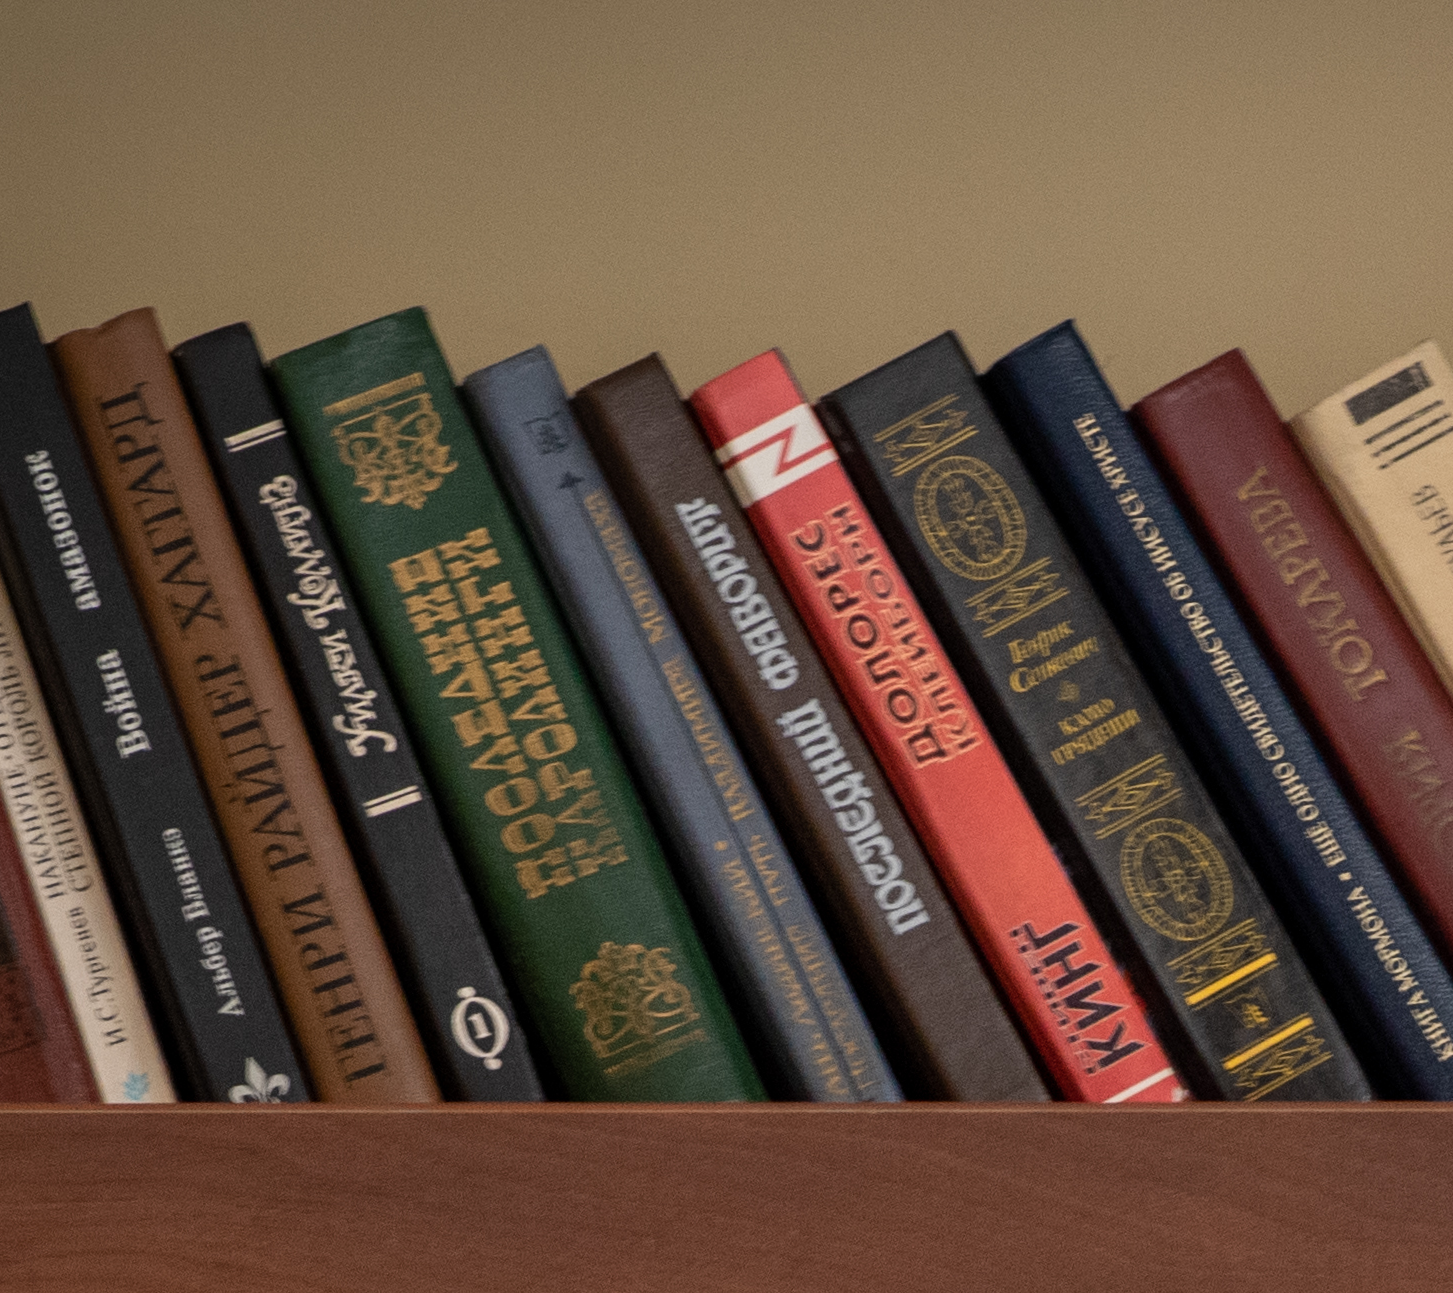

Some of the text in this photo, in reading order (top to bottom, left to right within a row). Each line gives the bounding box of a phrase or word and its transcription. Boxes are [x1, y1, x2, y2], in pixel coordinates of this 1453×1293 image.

[21, 447, 154, 760] Война амазонок
[248, 469, 399, 765] Уилки Коллинз
[784, 514, 950, 775] ДОЛОРЕС
[821, 497, 984, 759] КЛЕЙБОРН
[1113, 485, 1179, 575] ИИСУСЕ
[99, 381, 391, 1091] ГЕНРИ РАЙДЕР ХАГГАРД
[385, 544, 576, 901] ПОСЛЕДНИЕ
[439, 525, 621, 879] КАРОЛИНГИ
[671, 488, 937, 940] ПОСЛЕДНИЙ ФАВОРИТ
[1177, 598, 1289, 765] СВИДЕТЕЛЬСТВО
[189, 924, 248, 1023] Альбер
[1011, 920, 1143, 1074] КИНГ
[1343, 882, 1419, 994] МОРМОНА
